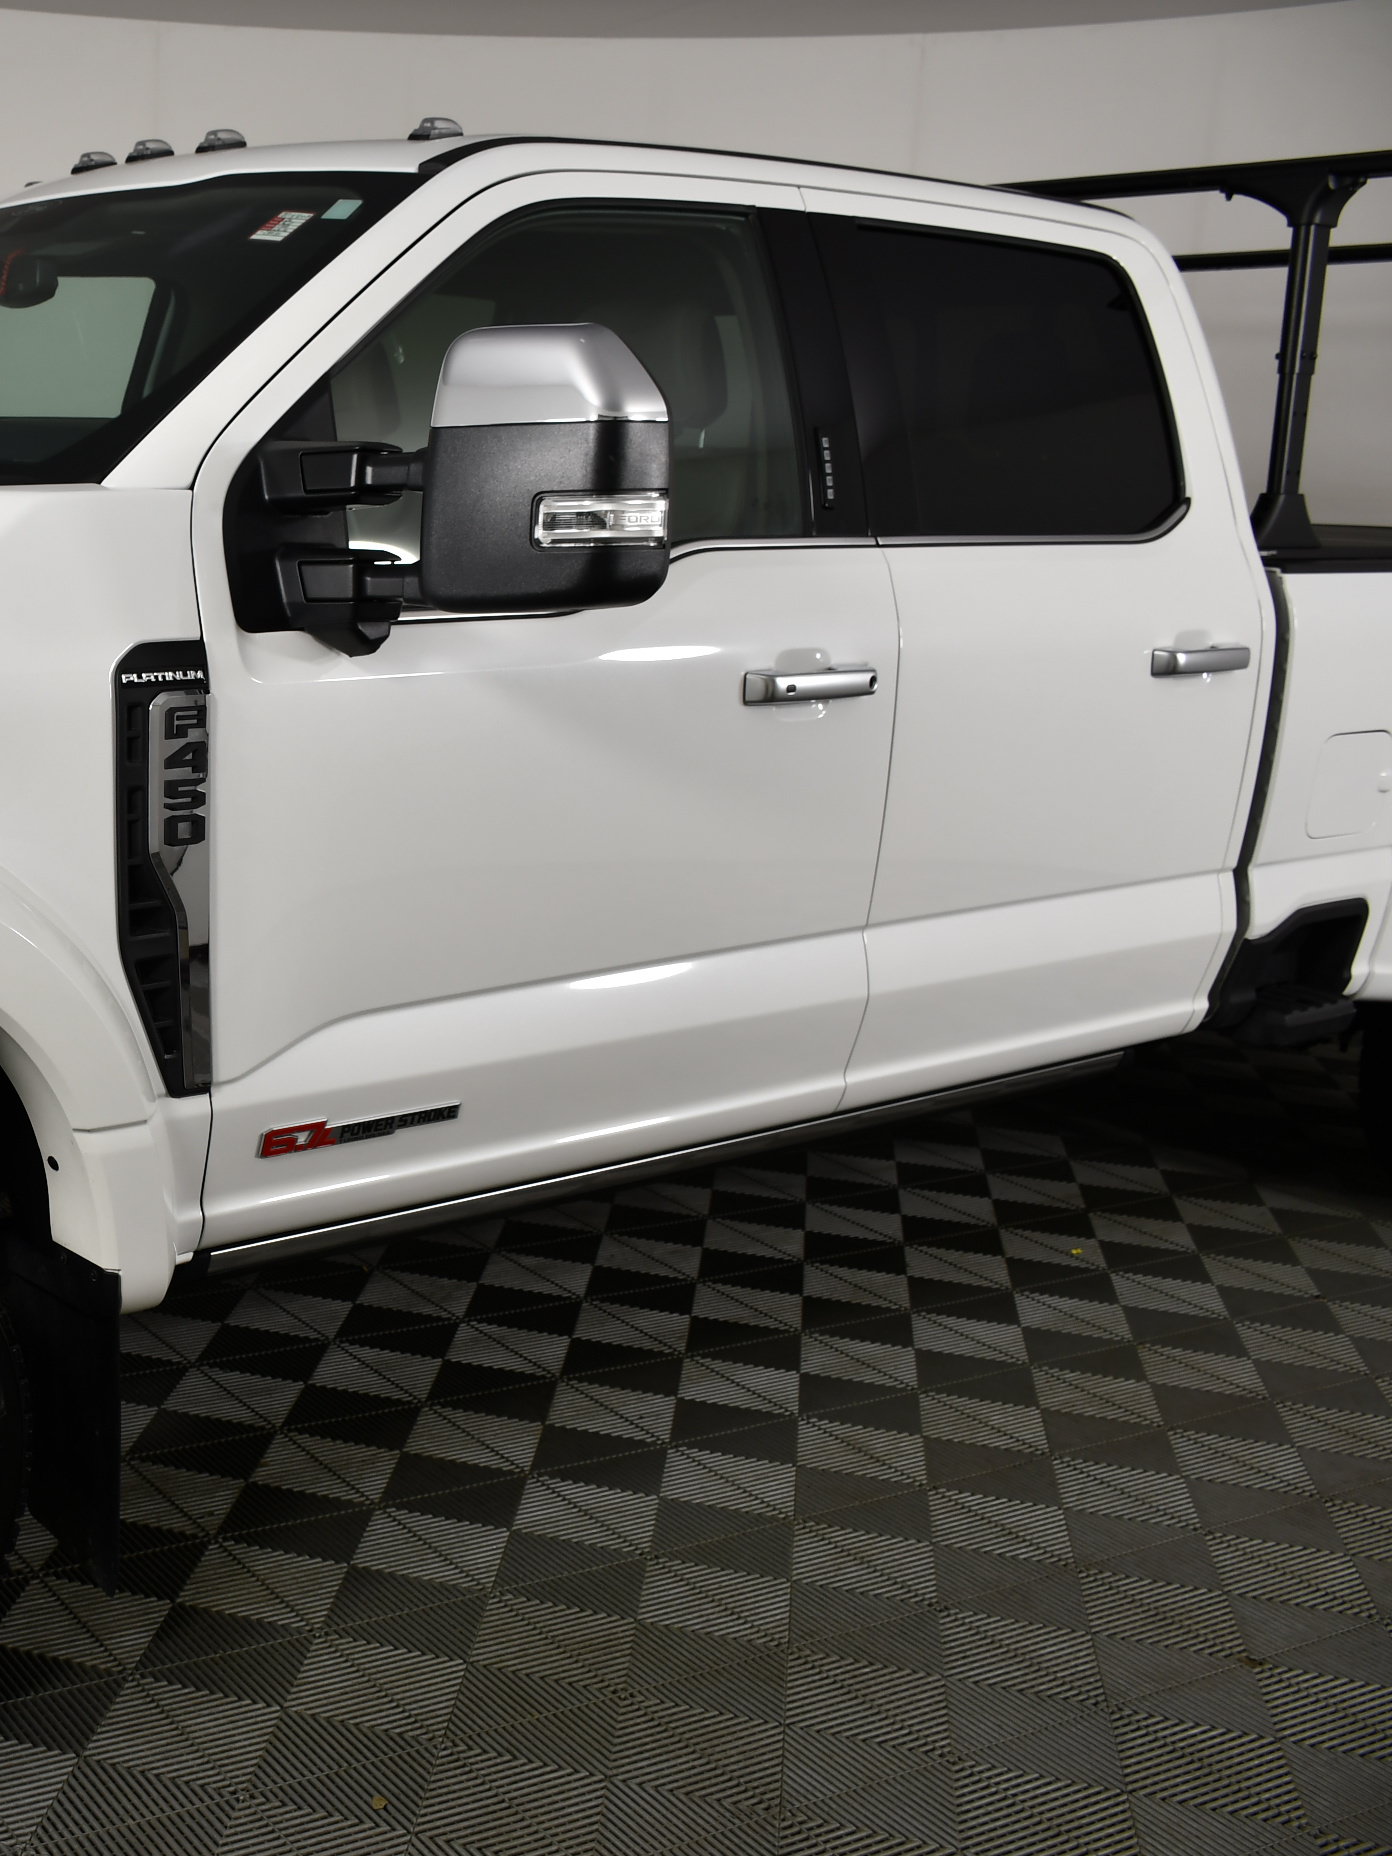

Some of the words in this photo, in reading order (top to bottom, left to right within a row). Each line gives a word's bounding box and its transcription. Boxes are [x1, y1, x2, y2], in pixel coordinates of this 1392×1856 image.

[121, 670, 206, 684] PLATINUM
[164, 705, 207, 847] F450
[262, 1120, 337, 1157] 6.7L
[339, 1116, 394, 1139] POWER
[397, 1105, 457, 1128] STROKE
